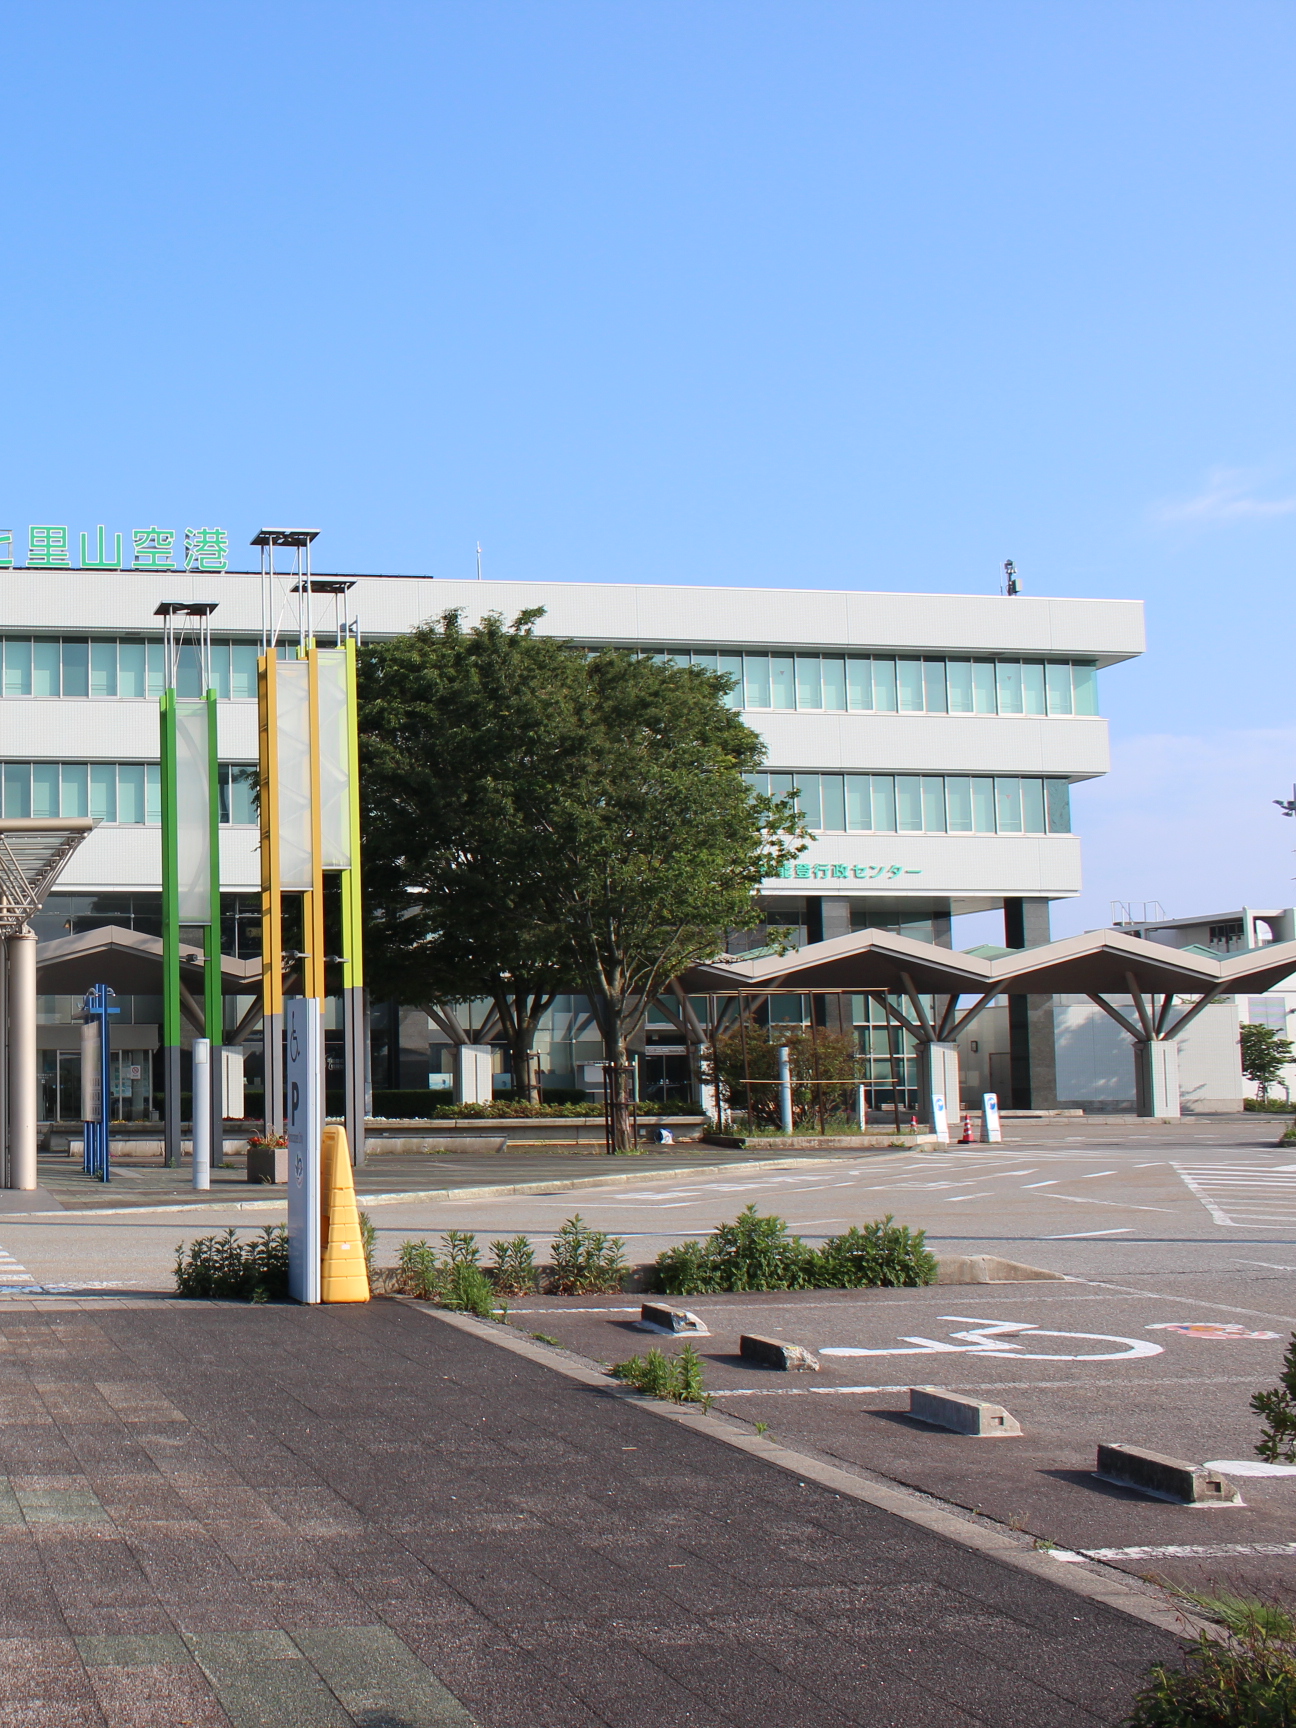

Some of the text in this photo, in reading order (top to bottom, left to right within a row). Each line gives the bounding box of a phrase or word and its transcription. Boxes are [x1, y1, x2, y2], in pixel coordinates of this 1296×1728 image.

[760, 863, 922, 880] 能登行政センター
[291, 1081, 300, 1127] P
